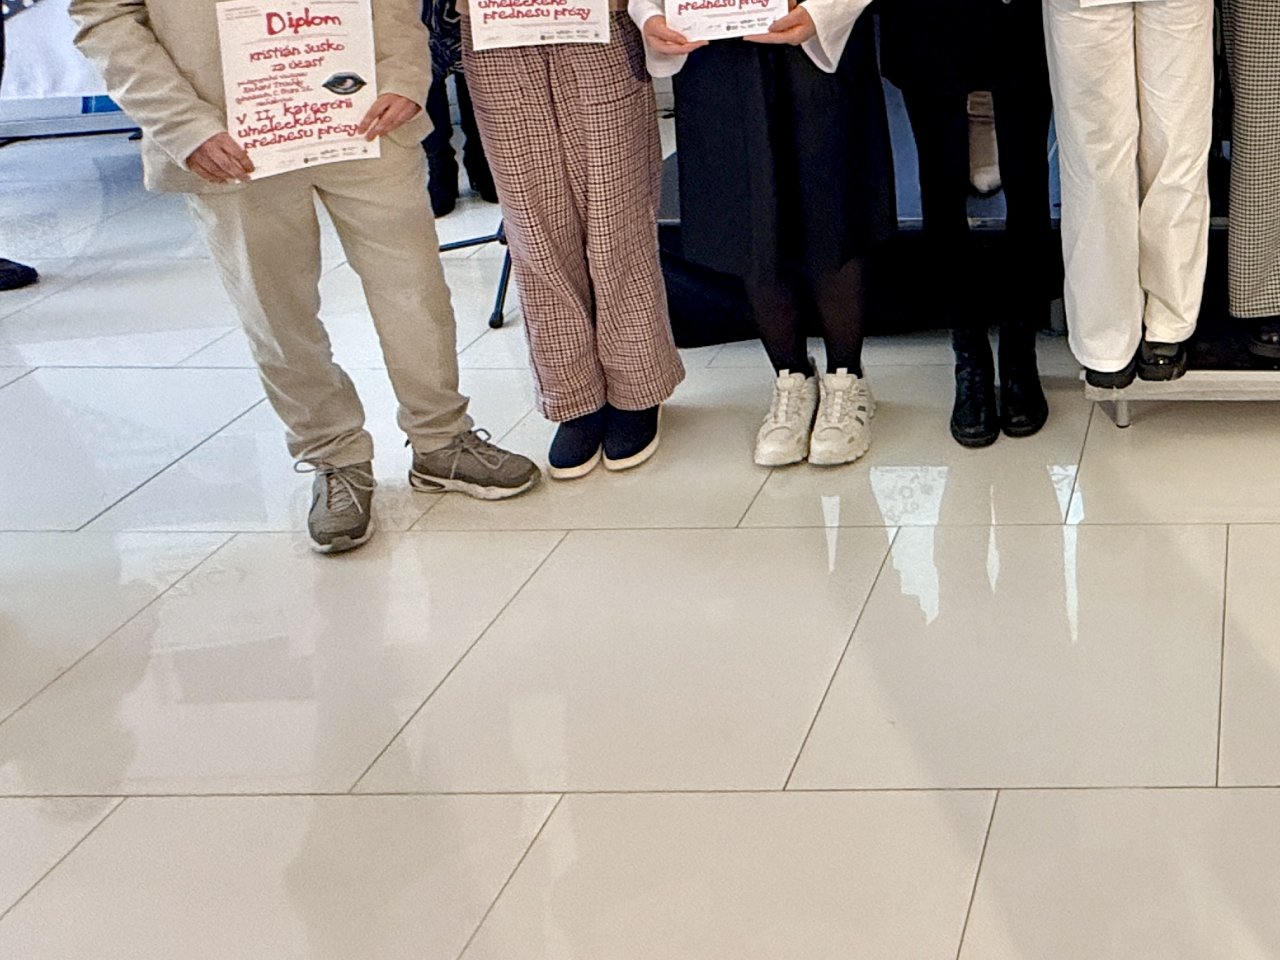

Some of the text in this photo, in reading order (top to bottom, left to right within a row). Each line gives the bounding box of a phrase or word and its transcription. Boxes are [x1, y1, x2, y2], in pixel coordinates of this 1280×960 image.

[266, 8, 341, 35] Diplom
[483, 7, 591, 24] prednesu prózy
[304, 39, 345, 54] Jusko
[284, 98, 353, 117] kategórii
[238, 115, 332, 138] umeleckého
[244, 124, 358, 154] prednesu prózy
